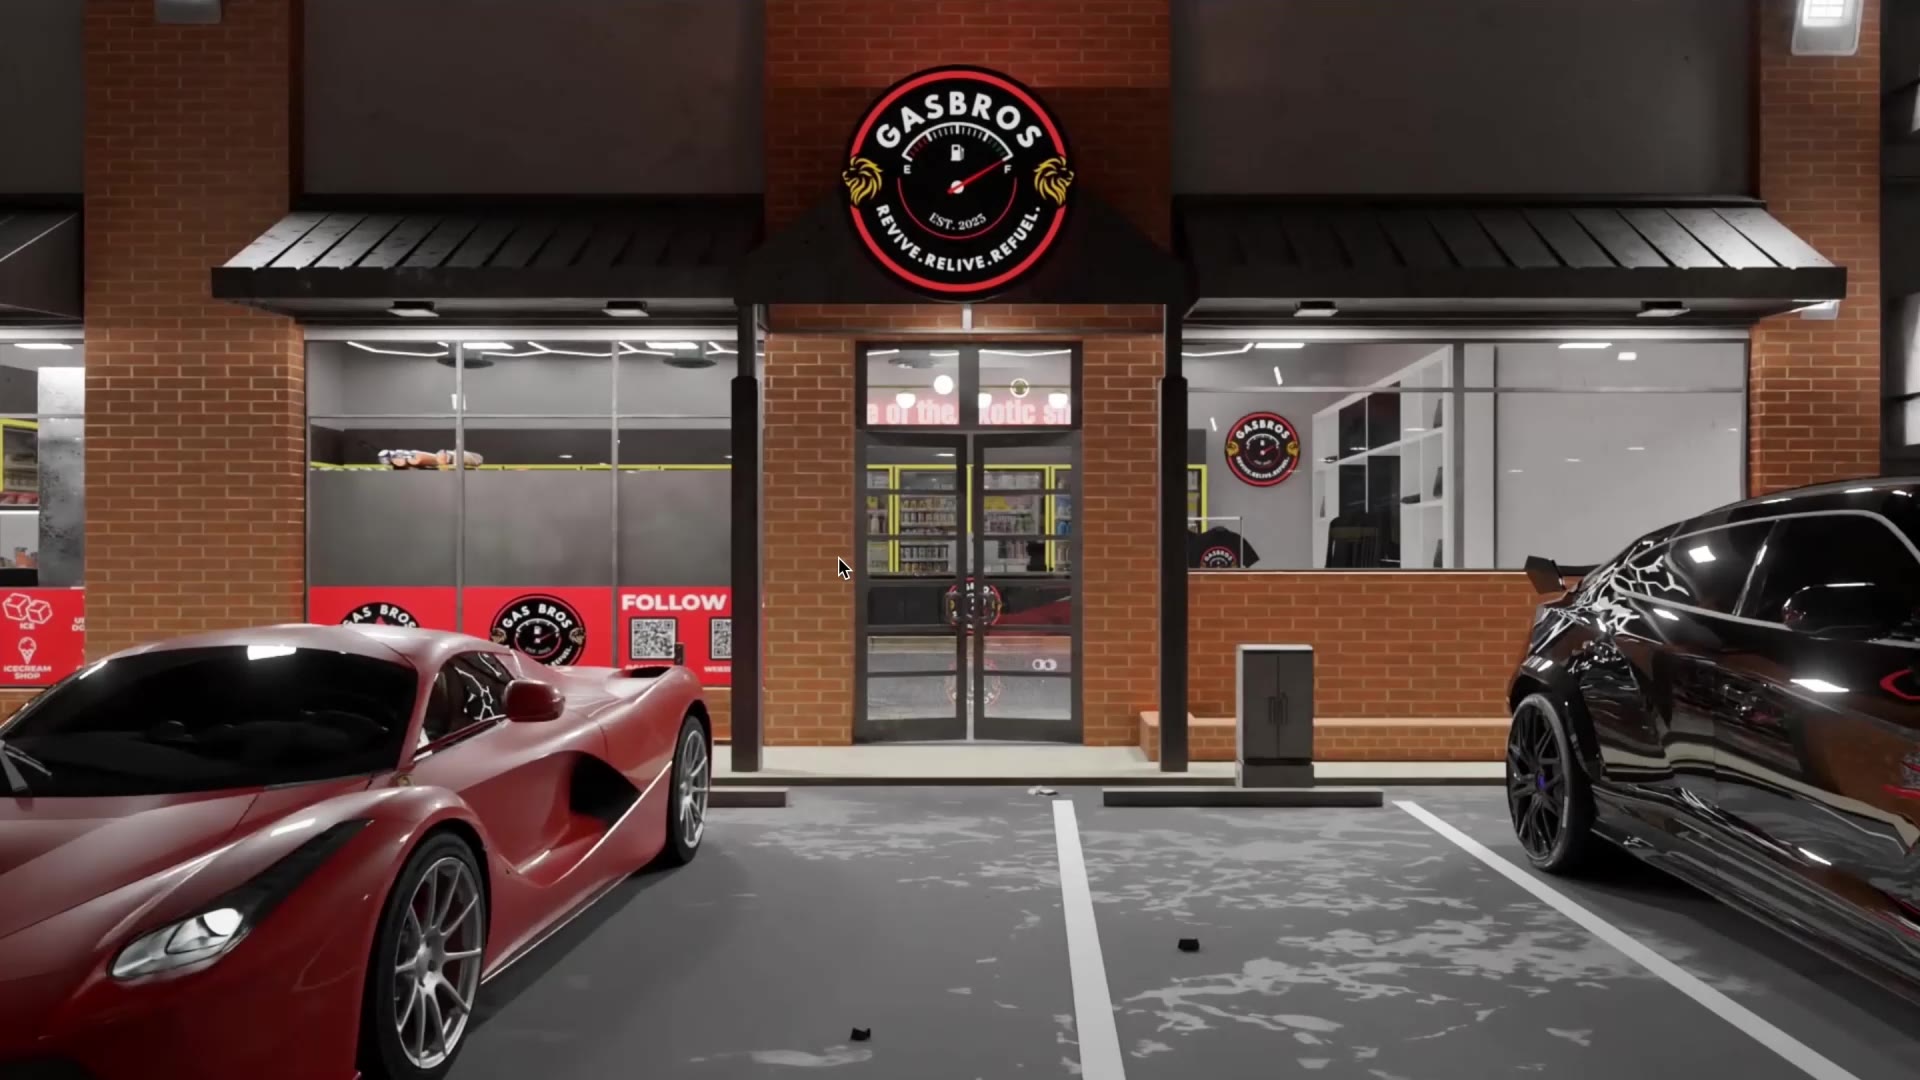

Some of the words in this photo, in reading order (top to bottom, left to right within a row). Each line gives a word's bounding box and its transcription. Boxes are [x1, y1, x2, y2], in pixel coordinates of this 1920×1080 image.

[876, 91, 1042, 148] GASBROS
[904, 165, 911, 174] E
[1004, 165, 1012, 174] F
[929, 212, 955, 230] EST.
[958, 212, 986, 230] 2025
[1236, 419, 1290, 439] GASBROS
[621, 594, 727, 611] FOLLOW
[502, 605, 531, 628] GAS
[538, 603, 573, 629] BROS
[19, 622, 35, 630] ICE
[14, 672, 41, 680] SHOP
